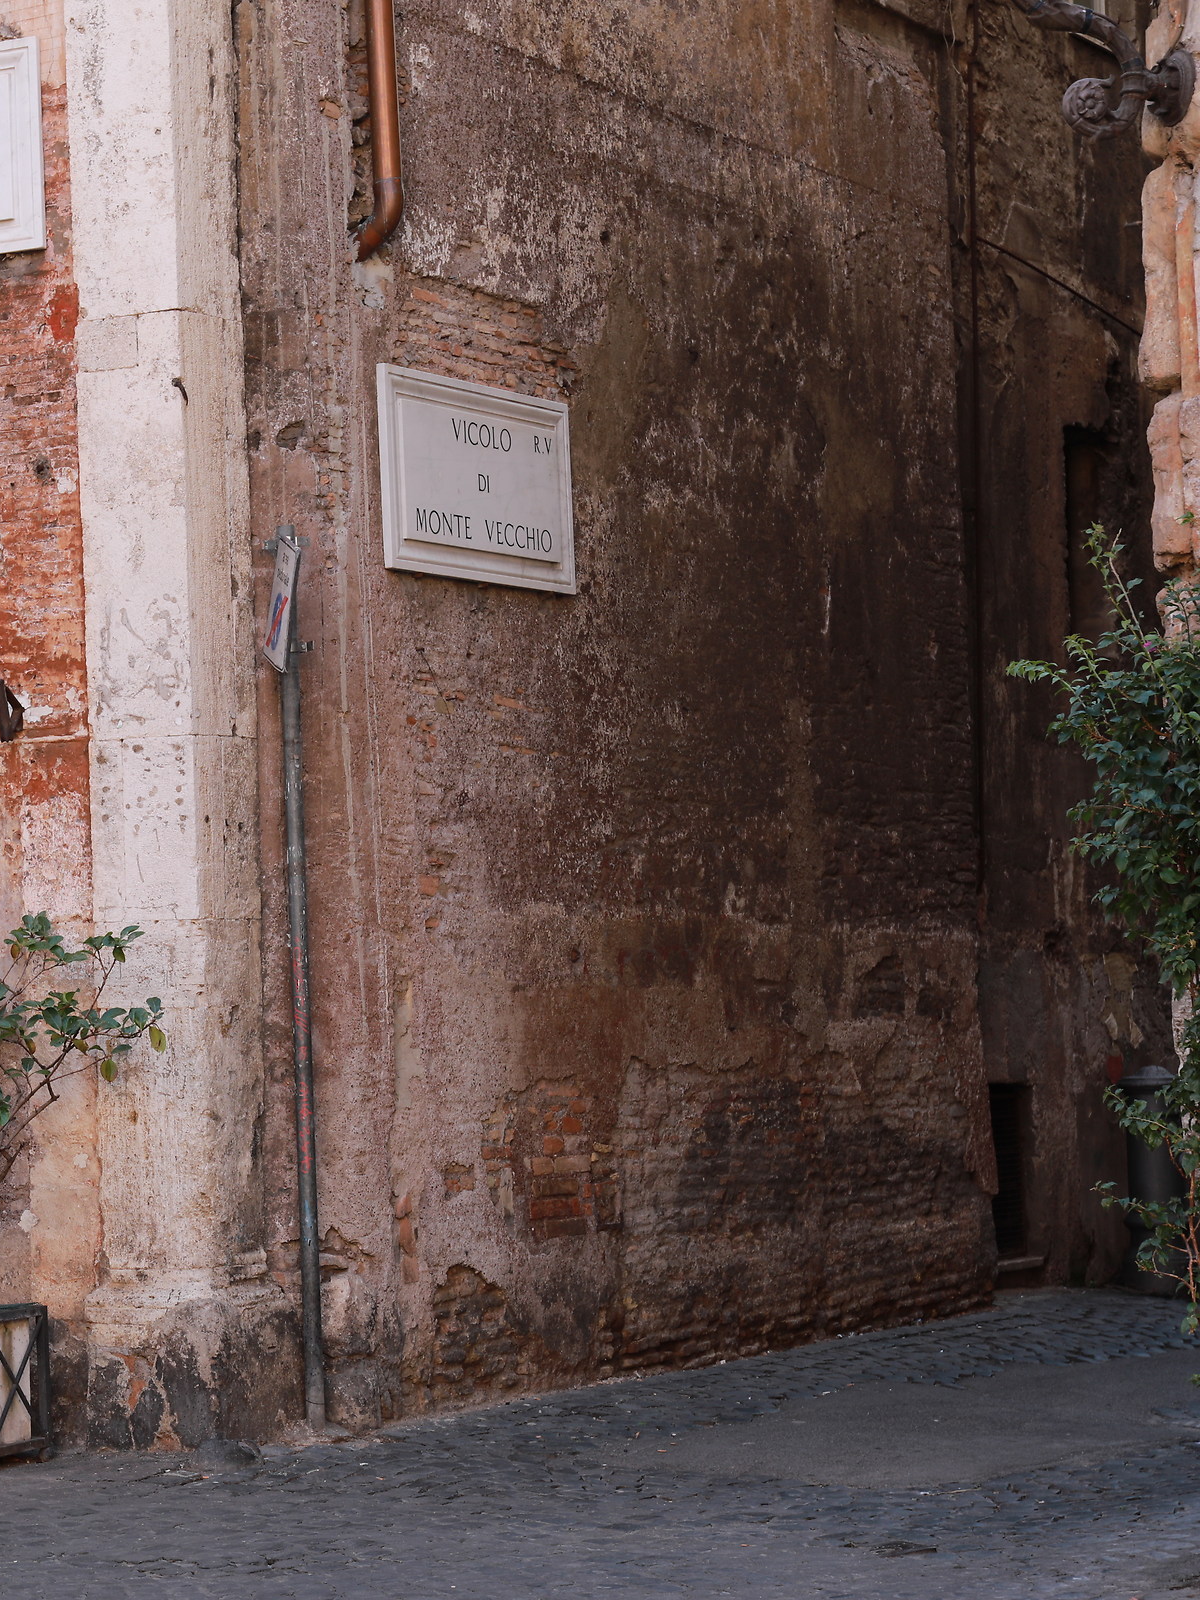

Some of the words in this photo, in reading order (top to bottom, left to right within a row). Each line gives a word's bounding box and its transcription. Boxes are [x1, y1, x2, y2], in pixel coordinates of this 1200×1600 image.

[451, 418, 512, 452] VICOLO
[477, 473, 490, 493] DI
[416, 507, 472, 540] MONTE
[485, 519, 552, 553] VECCHIO
